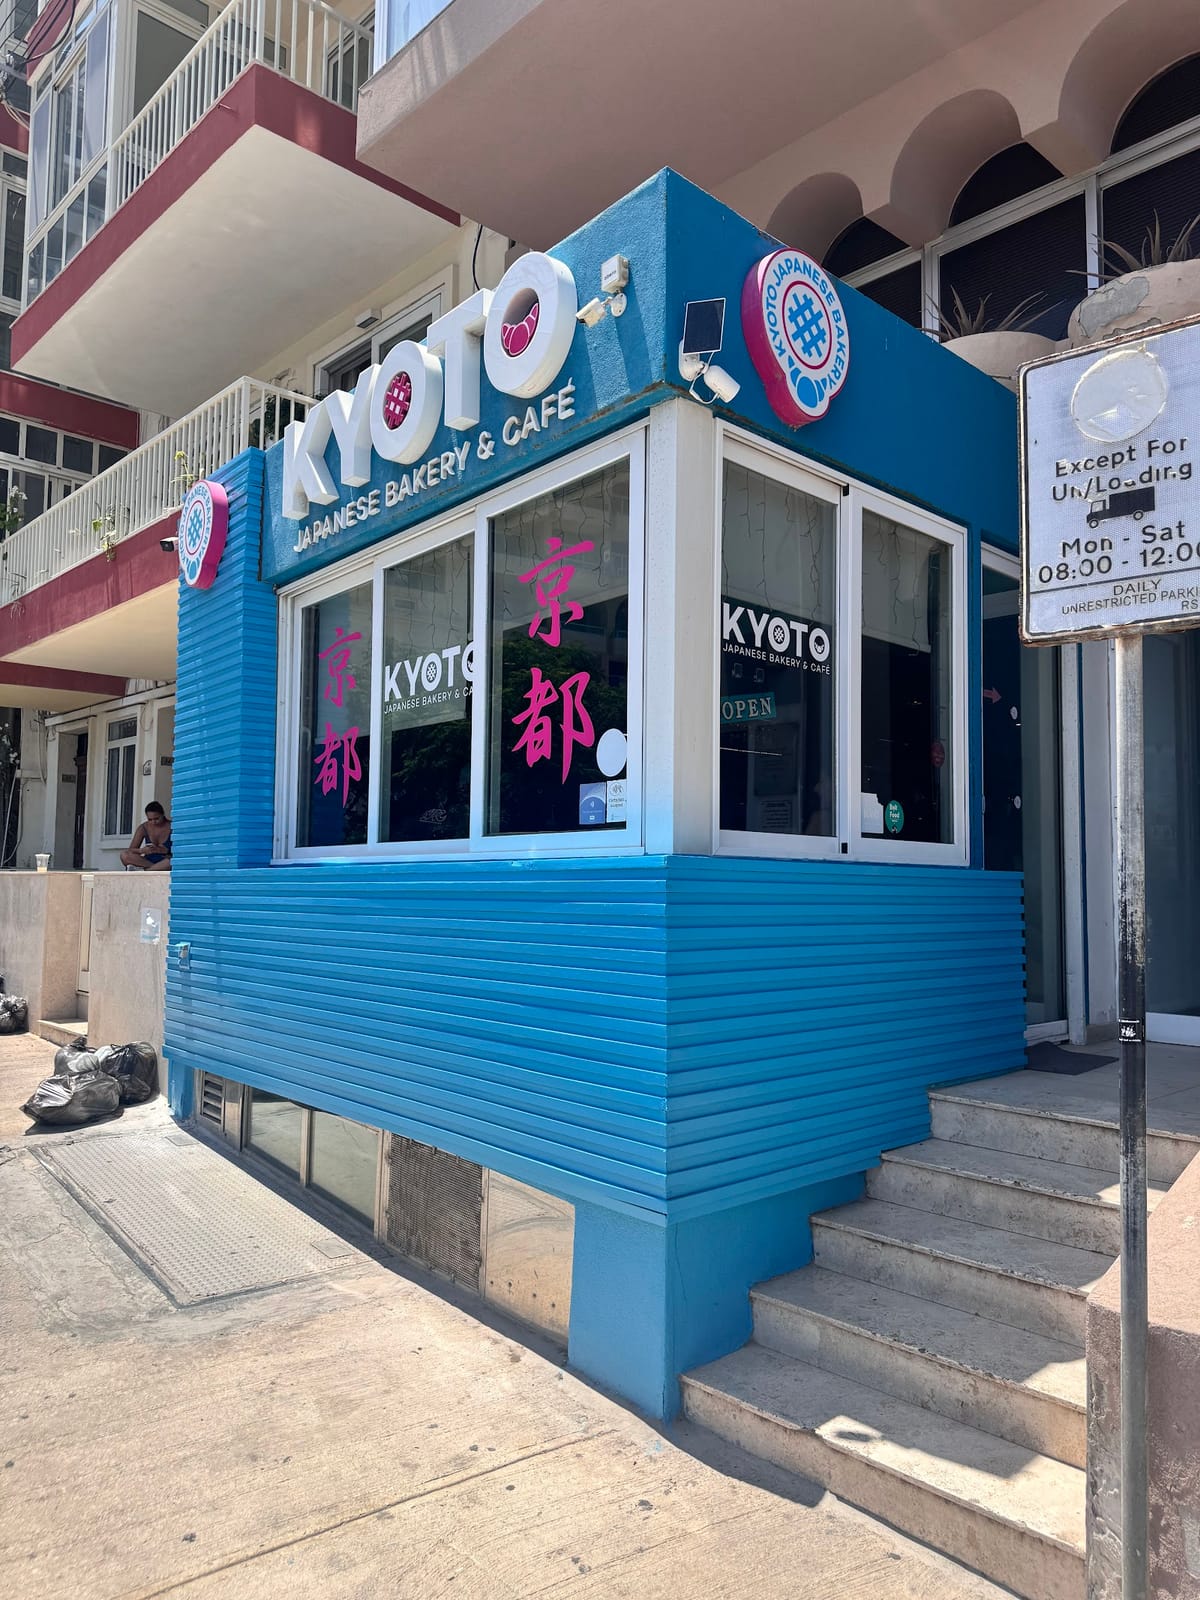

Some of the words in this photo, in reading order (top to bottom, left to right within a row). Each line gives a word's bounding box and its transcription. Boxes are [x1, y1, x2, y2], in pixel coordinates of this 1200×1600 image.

[772, 258, 835, 307] JAPANESE
[766, 284, 786, 358] KYOTO
[830, 308, 846, 391] BAKERY
[282, 252, 577, 520] KYOTO
[293, 488, 381, 553] JAPANESE
[385, 440, 471, 508] BAKERY
[476, 430, 495, 460] &
[502, 376, 577, 447] CAFÉ
[1055, 445, 1137, 478] Except
[1147, 437, 1189, 458] For
[1038, 555, 1113, 584] 08:00
[1139, 542, 1200, 568] 12:0
[1062, 538, 1113, 558] Mon
[1141, 520, 1186, 545] Sat
[1061, 592, 1158, 616] UNRESTRICTED
[1113, 578, 1162, 597] DAILY
[722, 602, 830, 662] KYOTO
[384, 640, 474, 702] KYOTO
[511, 537, 596, 785] 京都
[722, 642, 767, 661] JAPANESE
[769, 653, 800, 669] BAKERY
[802, 661, 808, 670] &
[811, 663, 831, 675] CAFÉ
[314, 628, 362, 808] 京都
[384, 697, 420, 714] JAPANESE
[422, 690, 453, 706] BAKERY
[454, 688, 460, 699] &
[722, 697, 772, 720] OPEN
